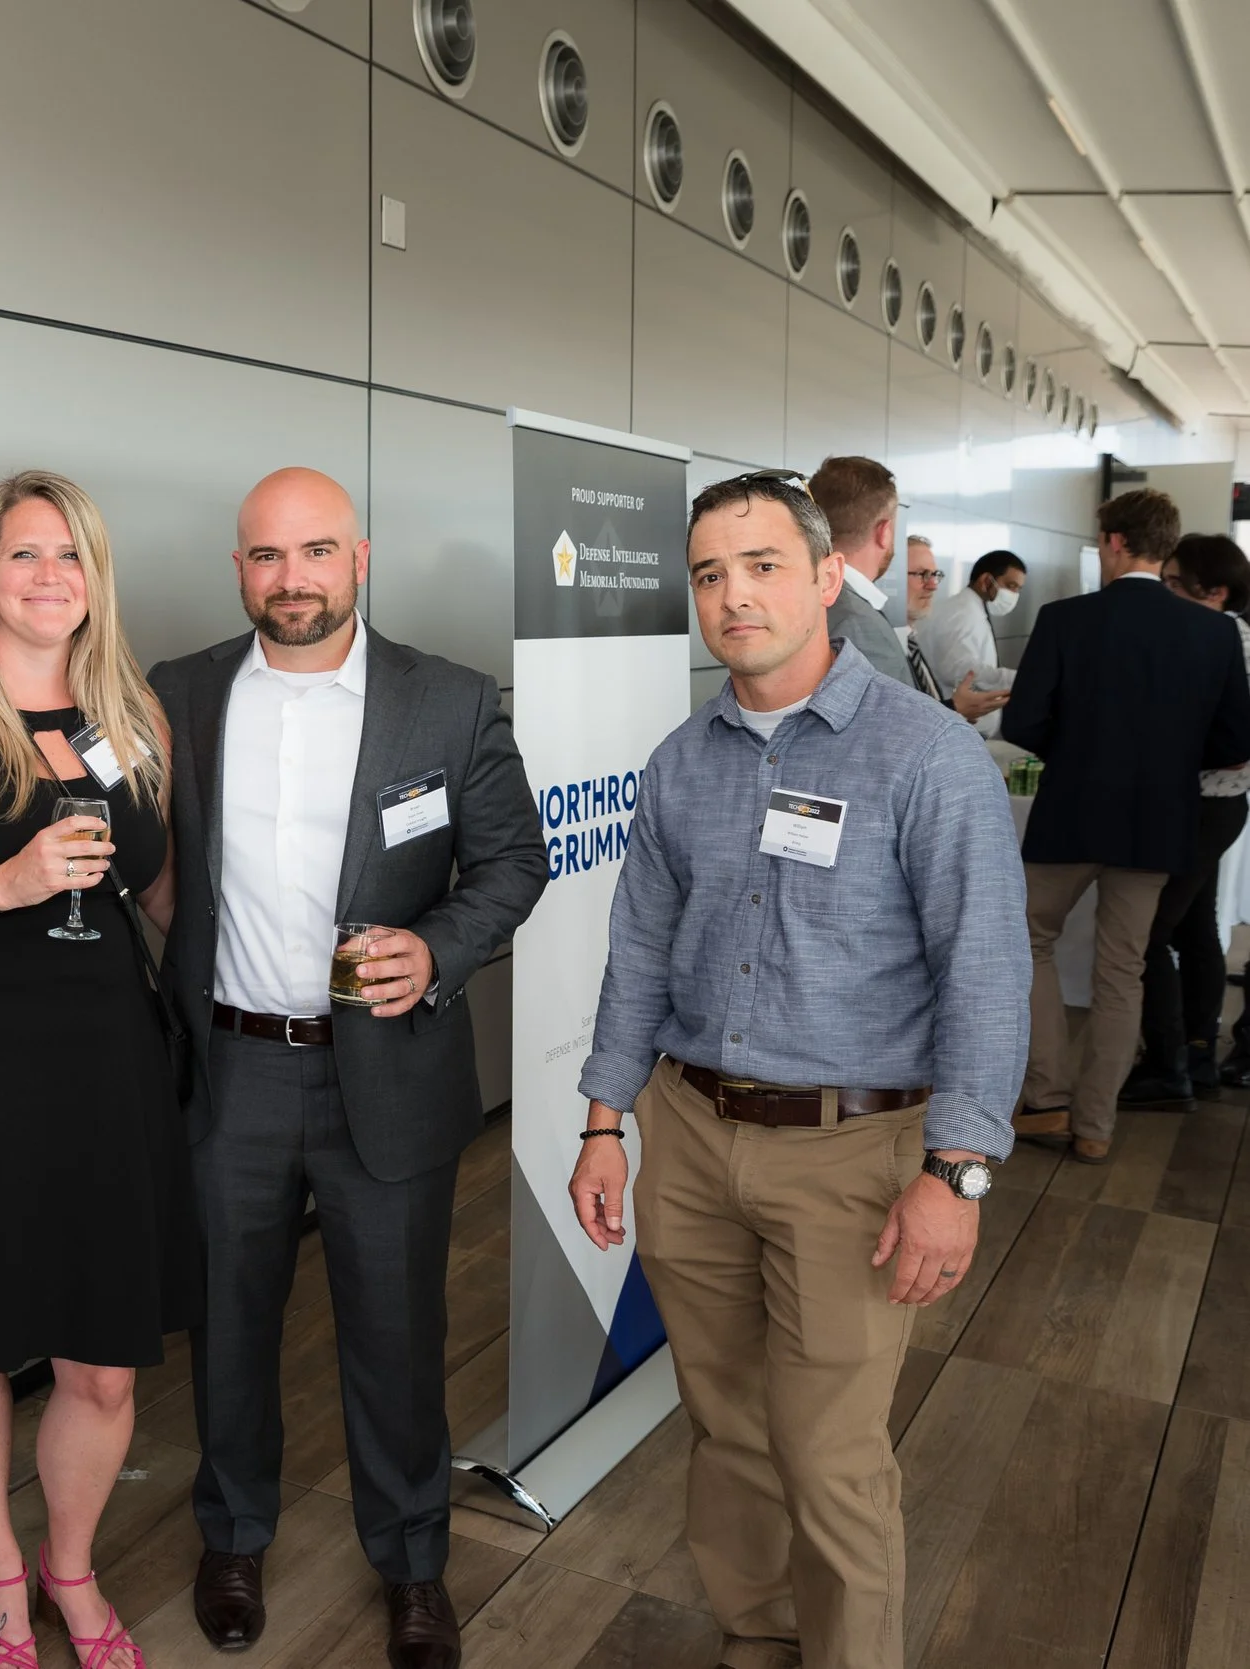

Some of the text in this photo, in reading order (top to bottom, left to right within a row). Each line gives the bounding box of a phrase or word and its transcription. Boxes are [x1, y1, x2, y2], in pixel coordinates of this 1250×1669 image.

[572, 487, 645, 511] PROUD SUPPORTER OF
[579, 543, 659, 565] DEFENSE INTELLIGENCE
[579, 570, 660, 590] MEMORIAL FOUNDATION
[539, 769, 645, 832] ORTHRO
